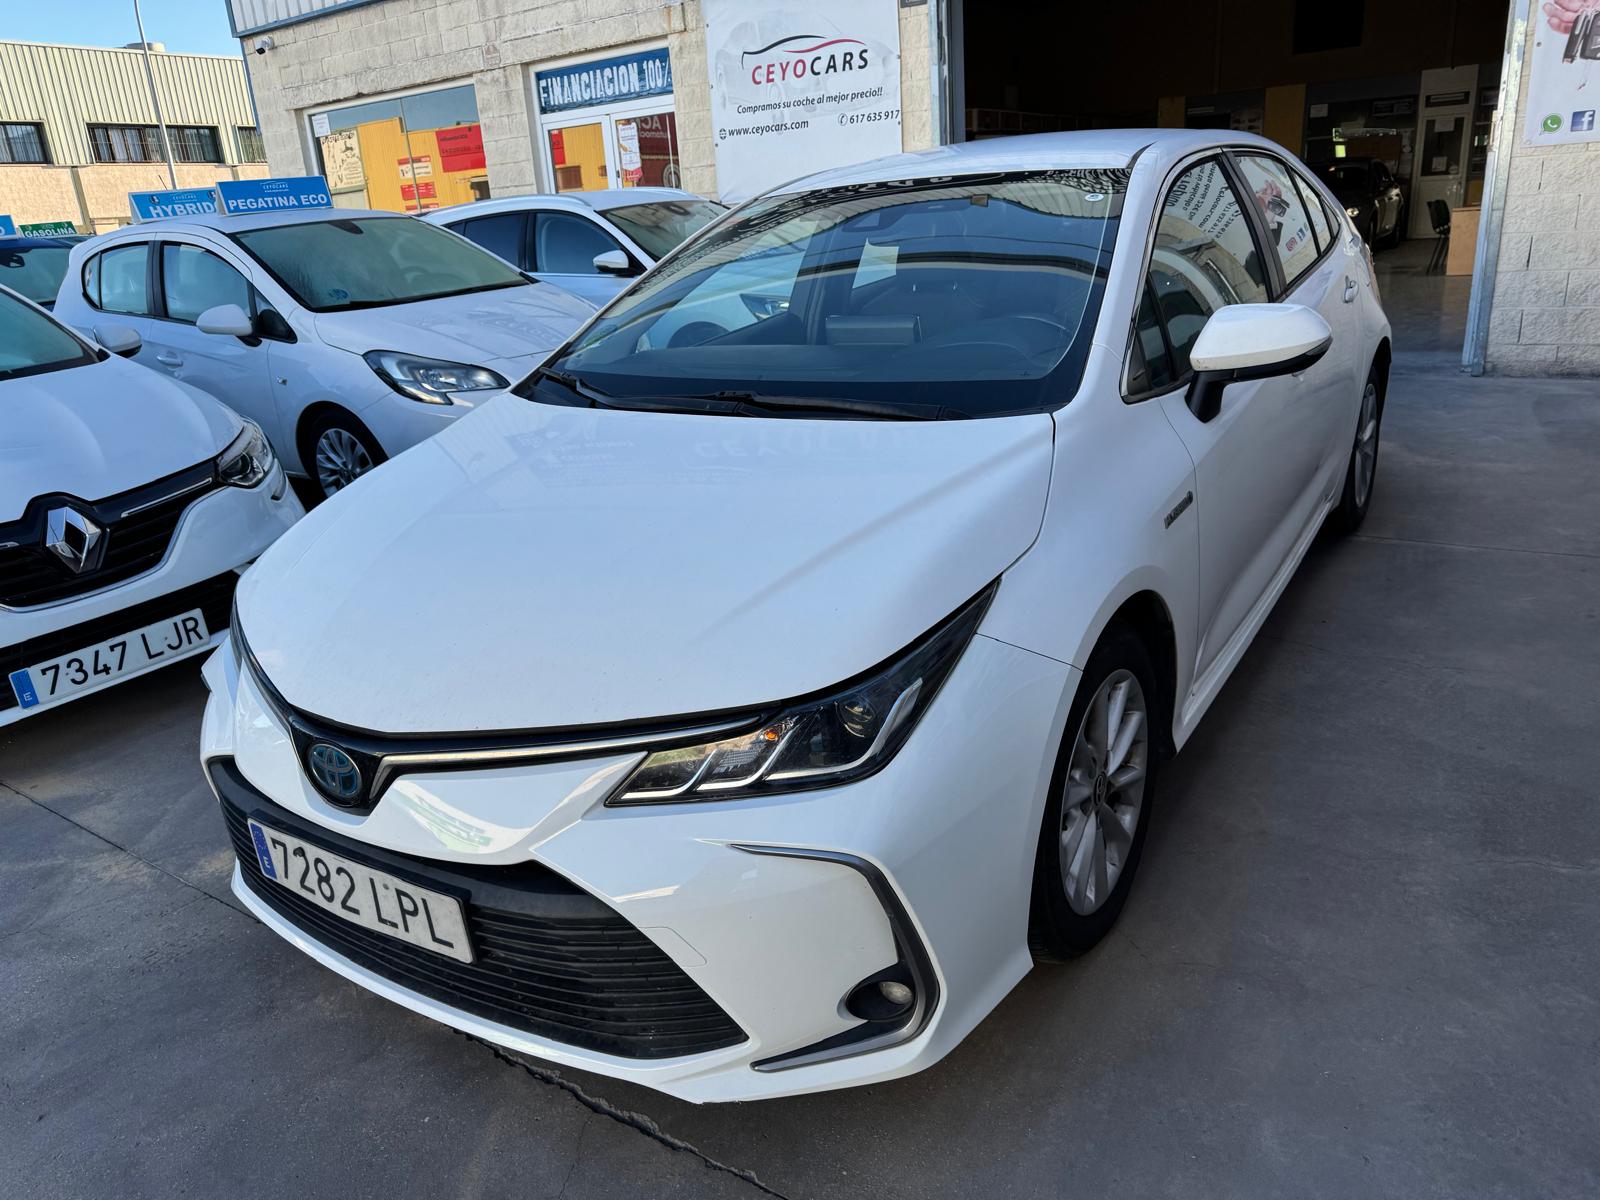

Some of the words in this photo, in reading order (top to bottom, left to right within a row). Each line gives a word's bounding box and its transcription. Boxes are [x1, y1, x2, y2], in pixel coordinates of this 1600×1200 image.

[752, 49, 868, 86] CEYOCARS
[540, 62, 639, 107] FINANCIACION
[642, 57, 671, 90] 100%
[737, 98, 781, 114] Compramos
[782, 99, 791, 109] su
[792, 95, 815, 107] coche
[817, 93, 825, 104] al
[826, 92, 850, 105] mejor
[851, 86, 883, 103] precio!!
[728, 119, 809, 137] www.ceyocars.com
[849, 113, 864, 125] 617
[866, 111, 882, 122] 635
[884, 110, 900, 120] 917
[148, 201, 217, 218] HYBRID
[228, 195, 298, 211] PEGATINA
[300, 193, 327, 205] ECO
[25, 227, 75, 238] GASOLINA
[41, 640, 127, 695] 7347
[141, 616, 203, 660] LJR
[270, 837, 360, 916] 7282
[369, 877, 454, 949] LPL
